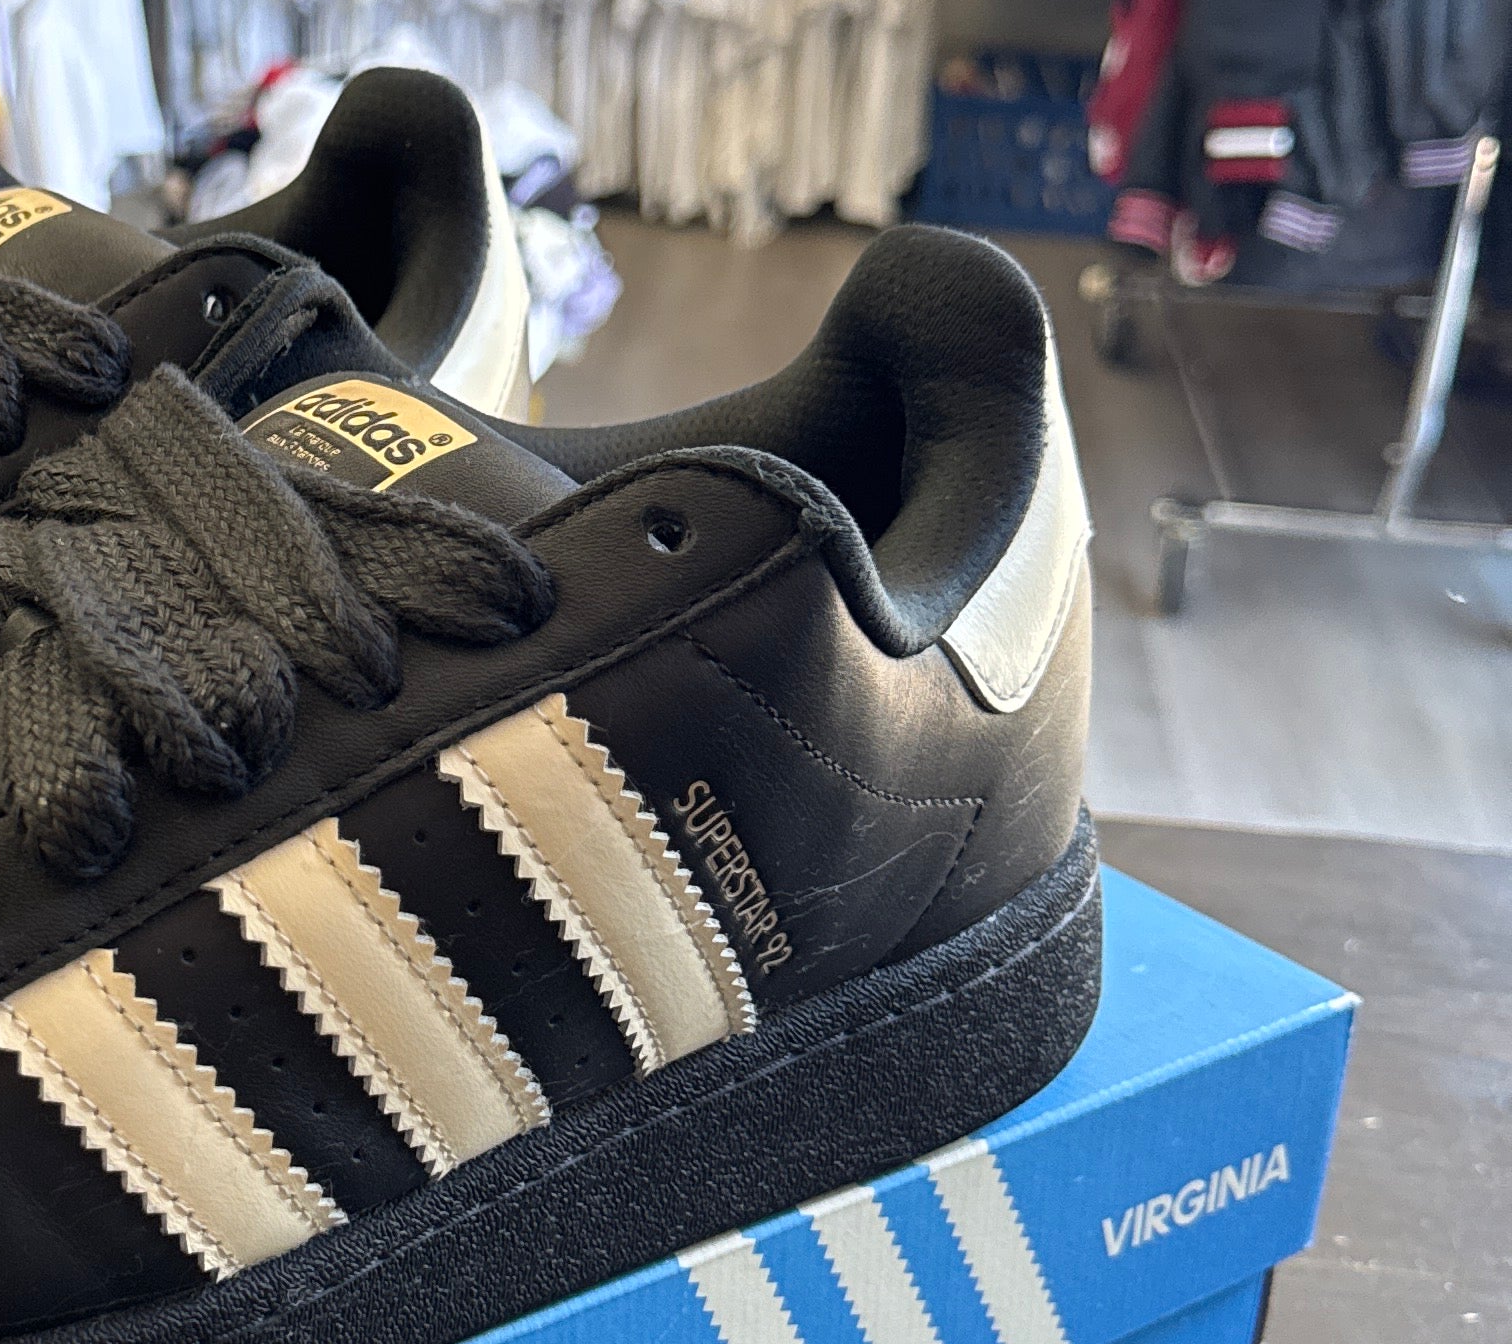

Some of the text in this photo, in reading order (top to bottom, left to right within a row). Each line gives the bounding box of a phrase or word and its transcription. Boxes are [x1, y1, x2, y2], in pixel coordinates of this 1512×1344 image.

[294, 392, 426, 465] adidas
[673, 779, 792, 974] SUPERSTAR 92
[1101, 1143, 1289, 1257] VIRGINIA
